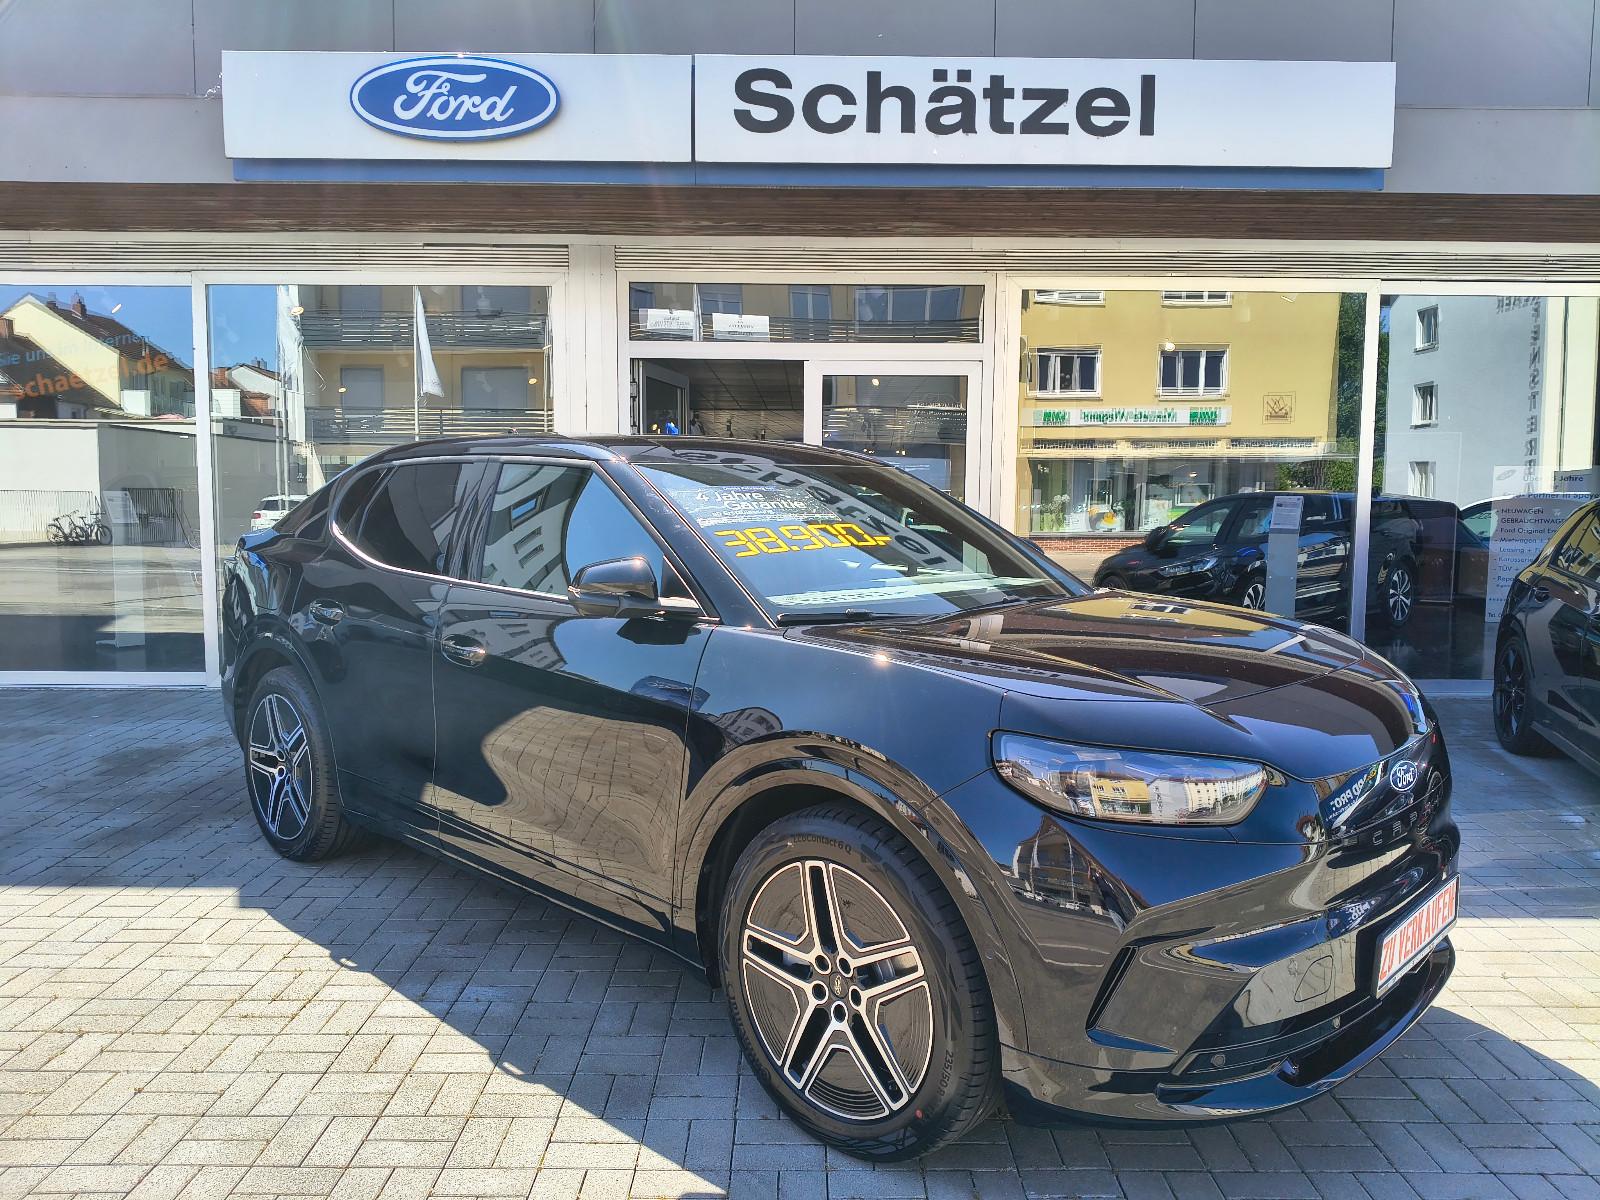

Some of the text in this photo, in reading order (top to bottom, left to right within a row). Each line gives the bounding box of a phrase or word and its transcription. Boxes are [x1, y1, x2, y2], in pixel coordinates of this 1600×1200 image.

[393, 69, 518, 122] Ford
[733, 67, 1156, 138] Schätzel
[714, 490, 765, 502] Jahre
[723, 499, 808, 511] Garantie
[1396, 764, 1415, 788] Ford
[1378, 881, 1457, 981] ZU VERKAUFEN
